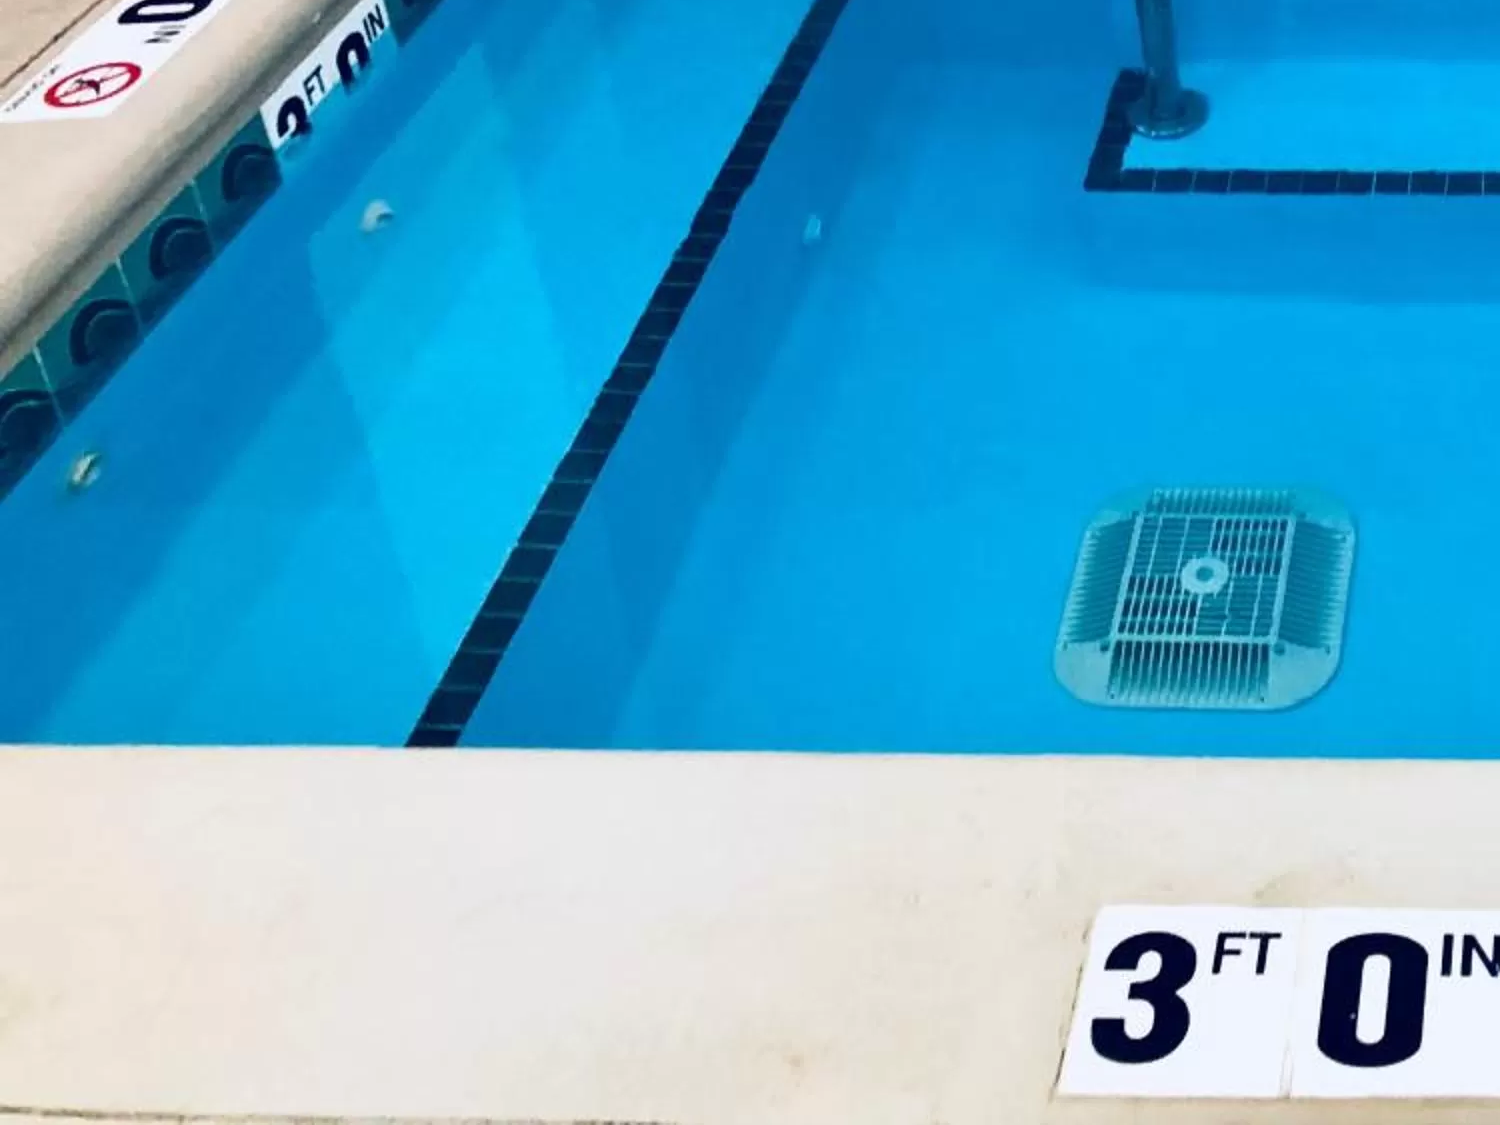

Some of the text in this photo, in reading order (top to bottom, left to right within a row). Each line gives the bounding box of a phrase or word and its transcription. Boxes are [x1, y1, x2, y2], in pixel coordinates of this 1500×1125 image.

[303, 64, 326, 107] FT
[335, 30, 372, 88] 0
[362, 6, 386, 44] IN
[1091, 930, 1197, 1064] 3
[1212, 931, 1282, 976] FT
[1317, 932, 1429, 1068] 0
